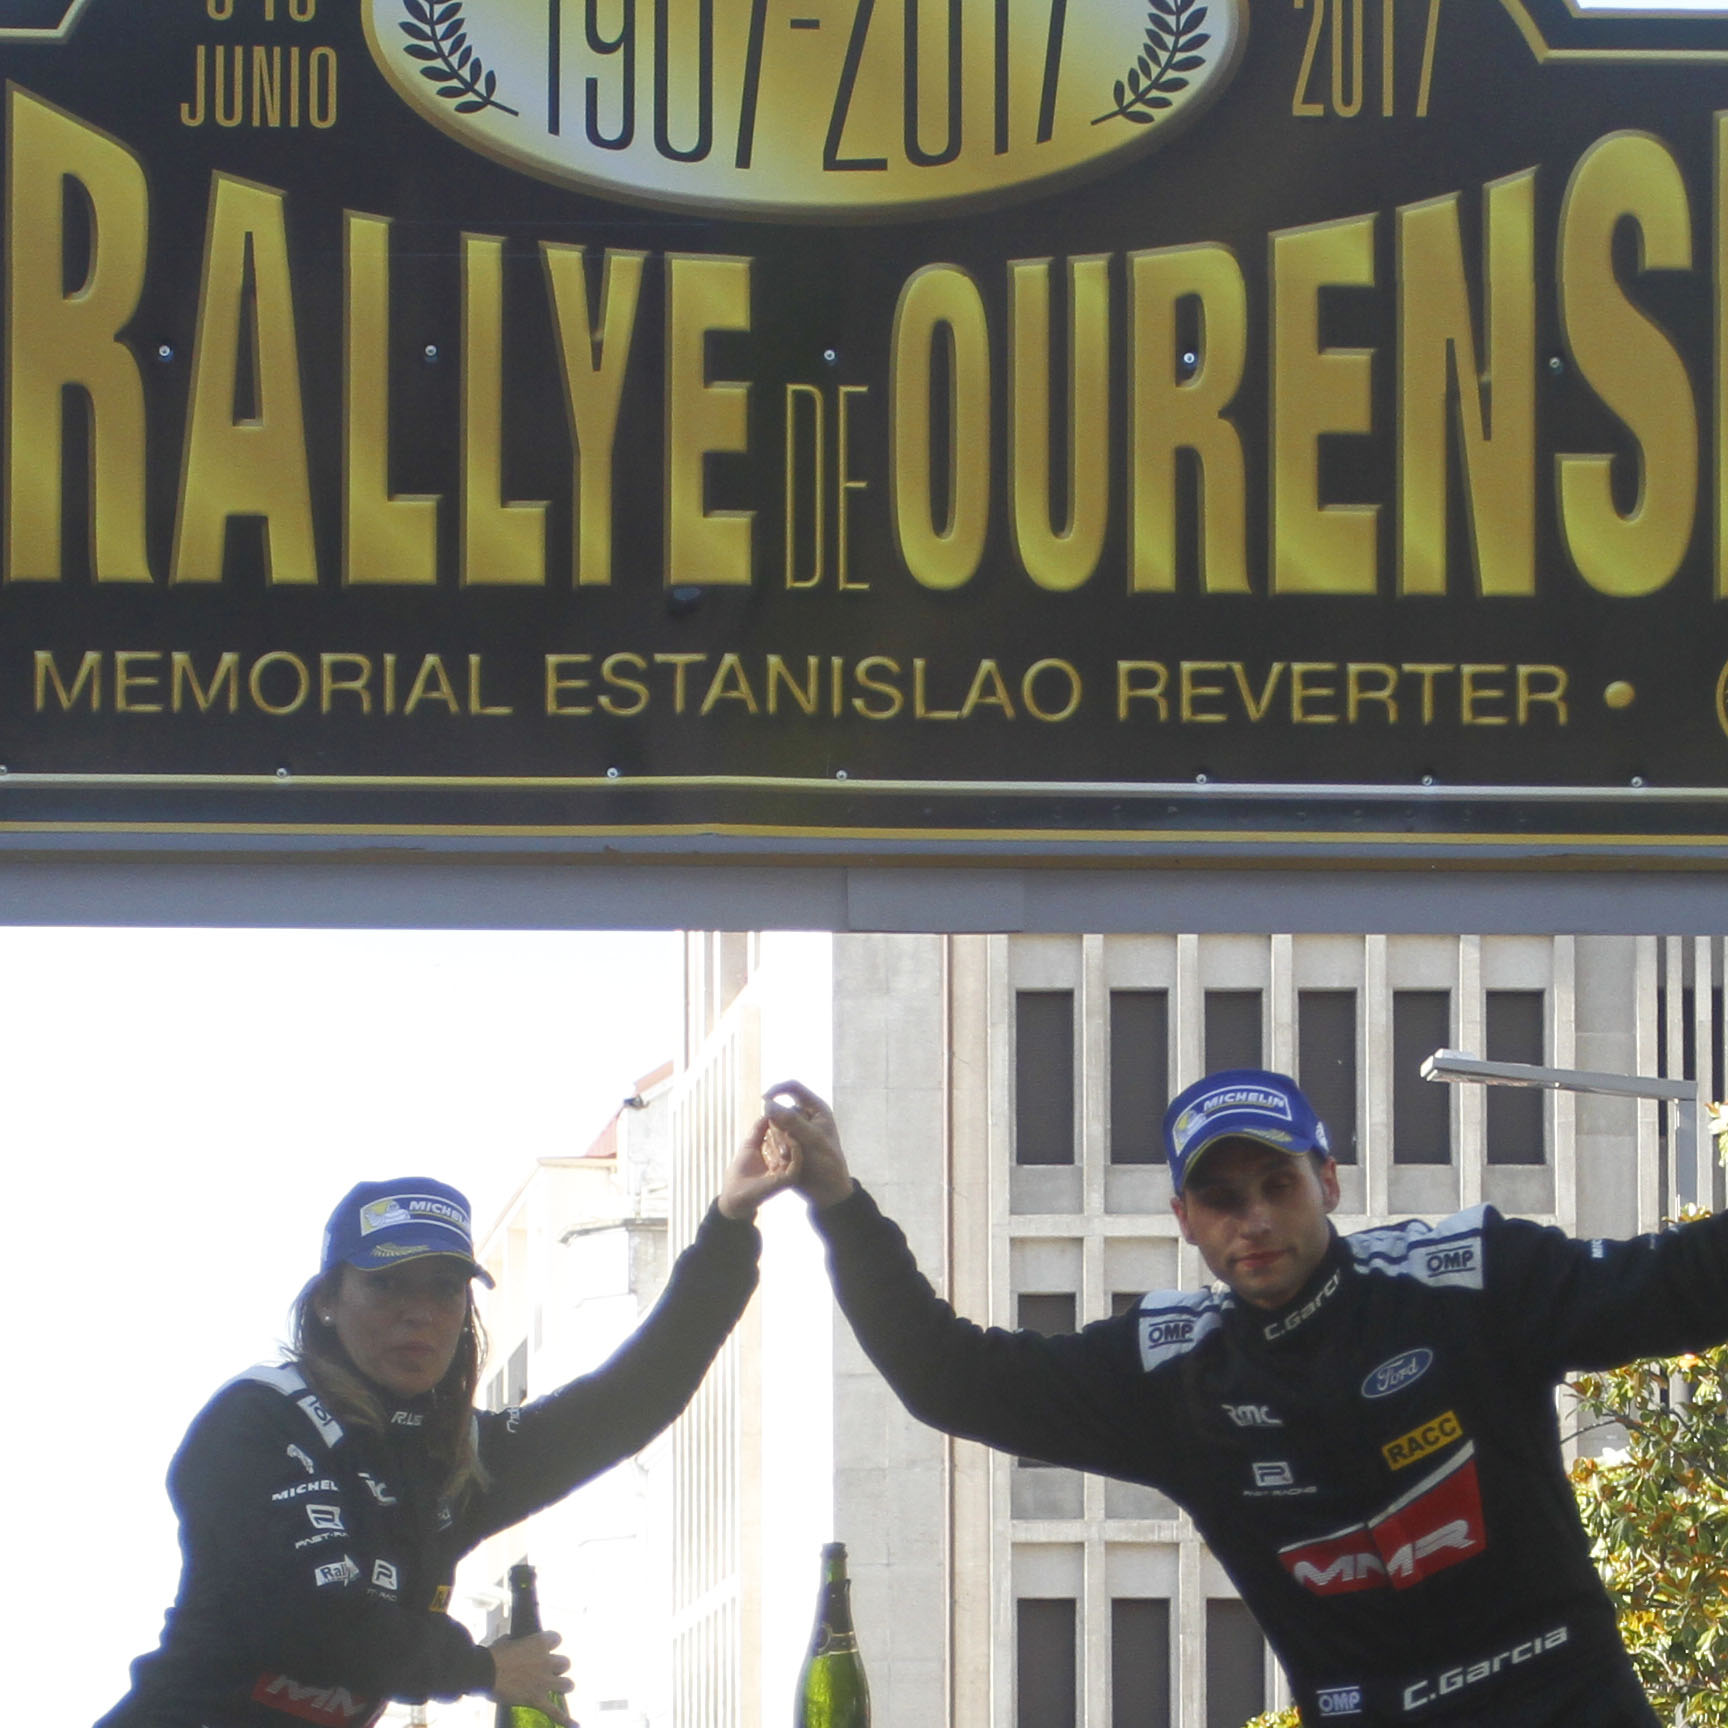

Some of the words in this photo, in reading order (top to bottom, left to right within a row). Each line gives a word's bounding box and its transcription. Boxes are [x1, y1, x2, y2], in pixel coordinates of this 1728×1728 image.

[180, 46, 339, 129] JUNIO
[2, 79, 756, 591] RALLYE
[784, 383, 870, 591] DE
[33, 649, 512, 717] MEMORIAL
[543, 653, 1082, 724] ESTANISLAO
[1118, 659, 1570, 727] REVERTER
[1202, 1091, 1286, 1110] MICHELIN
[408, 1199, 471, 1227] MICHEL
[1426, 1249, 1474, 1272] OMP
[1148, 1323, 1194, 1345] OMP
[1374, 1353, 1421, 1391] Ford
[1386, 1417, 1457, 1465] RACC
[271, 1480, 339, 1501] MICHEL
[1318, 1690, 1361, 1712] OMP
